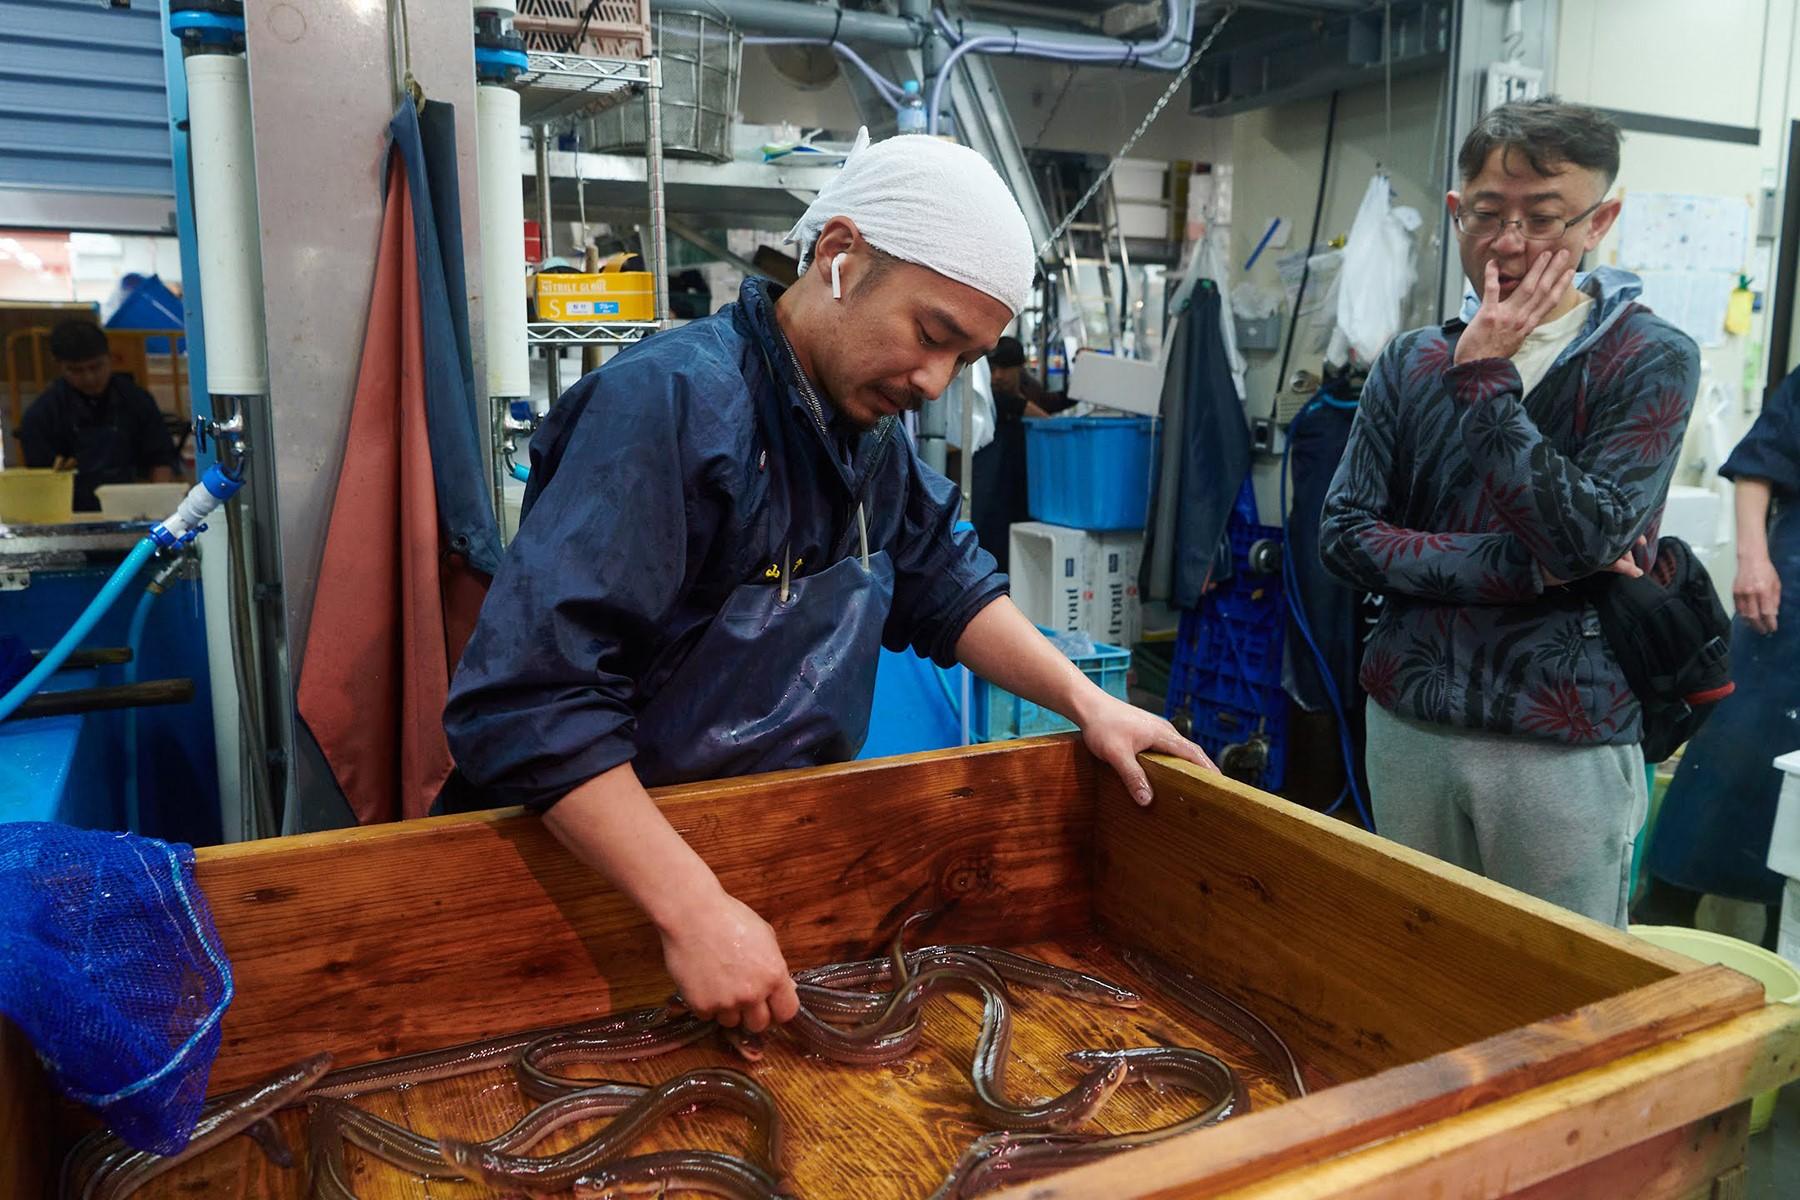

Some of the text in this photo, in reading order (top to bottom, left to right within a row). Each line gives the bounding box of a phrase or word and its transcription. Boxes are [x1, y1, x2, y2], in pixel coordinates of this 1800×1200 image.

[541, 279, 577, 294] NITRILE
[550, 299, 561, 318] S
[1066, 589, 1078, 631] rout
